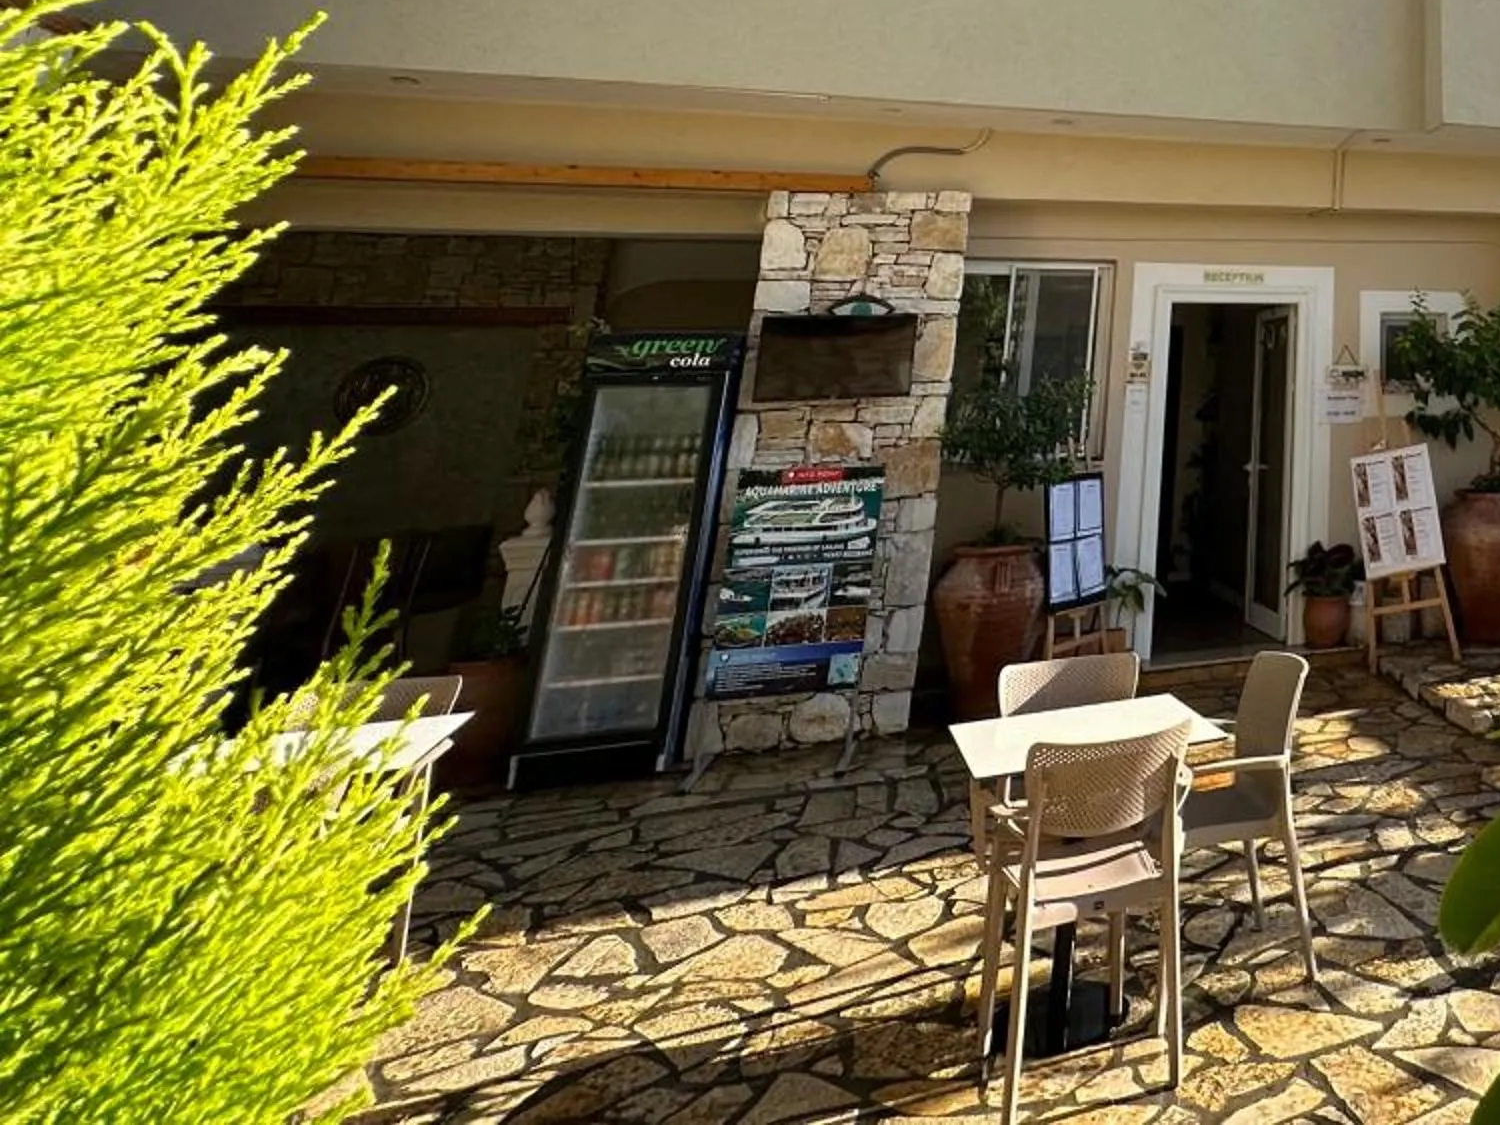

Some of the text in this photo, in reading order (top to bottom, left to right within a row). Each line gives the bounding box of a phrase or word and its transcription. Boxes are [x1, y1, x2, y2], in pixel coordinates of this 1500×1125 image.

[632, 337, 727, 360] green
[669, 352, 711, 368] cola
[816, 480, 877, 494] ADVENTURE
